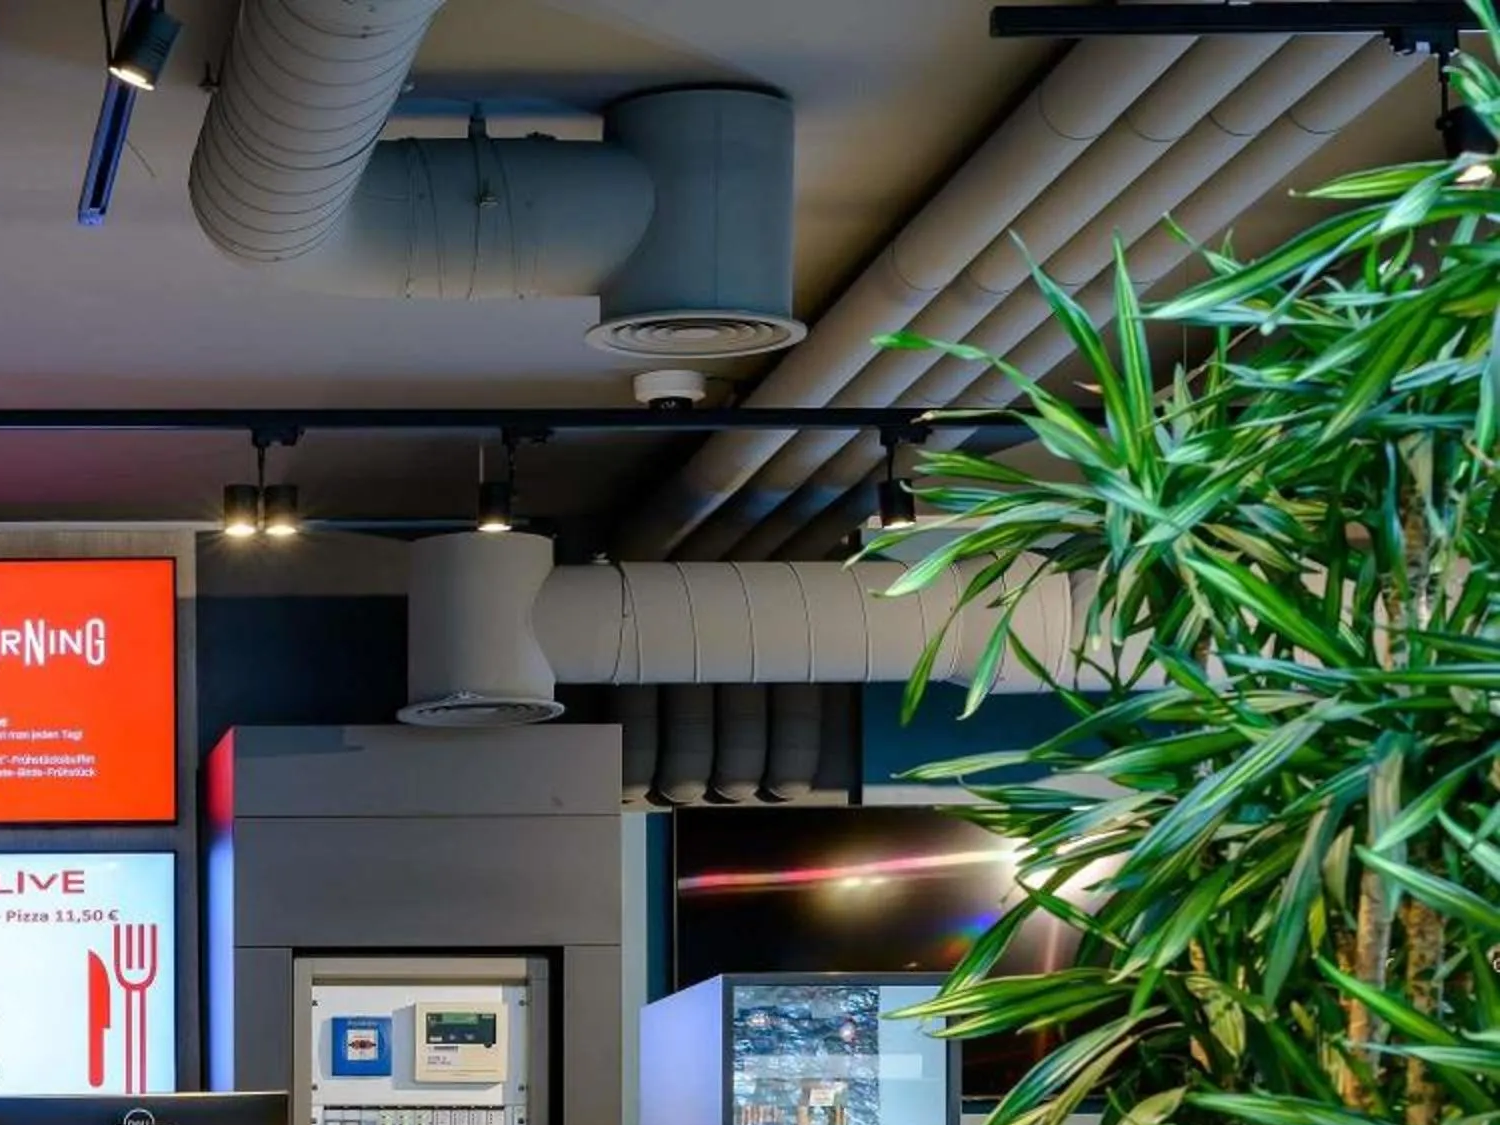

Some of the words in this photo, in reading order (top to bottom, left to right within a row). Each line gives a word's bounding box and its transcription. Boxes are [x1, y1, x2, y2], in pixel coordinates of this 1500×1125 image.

[5, 909, 49, 924] Pizza
[55, 909, 104, 925] 11,50
[106, 909, 119, 922] €
